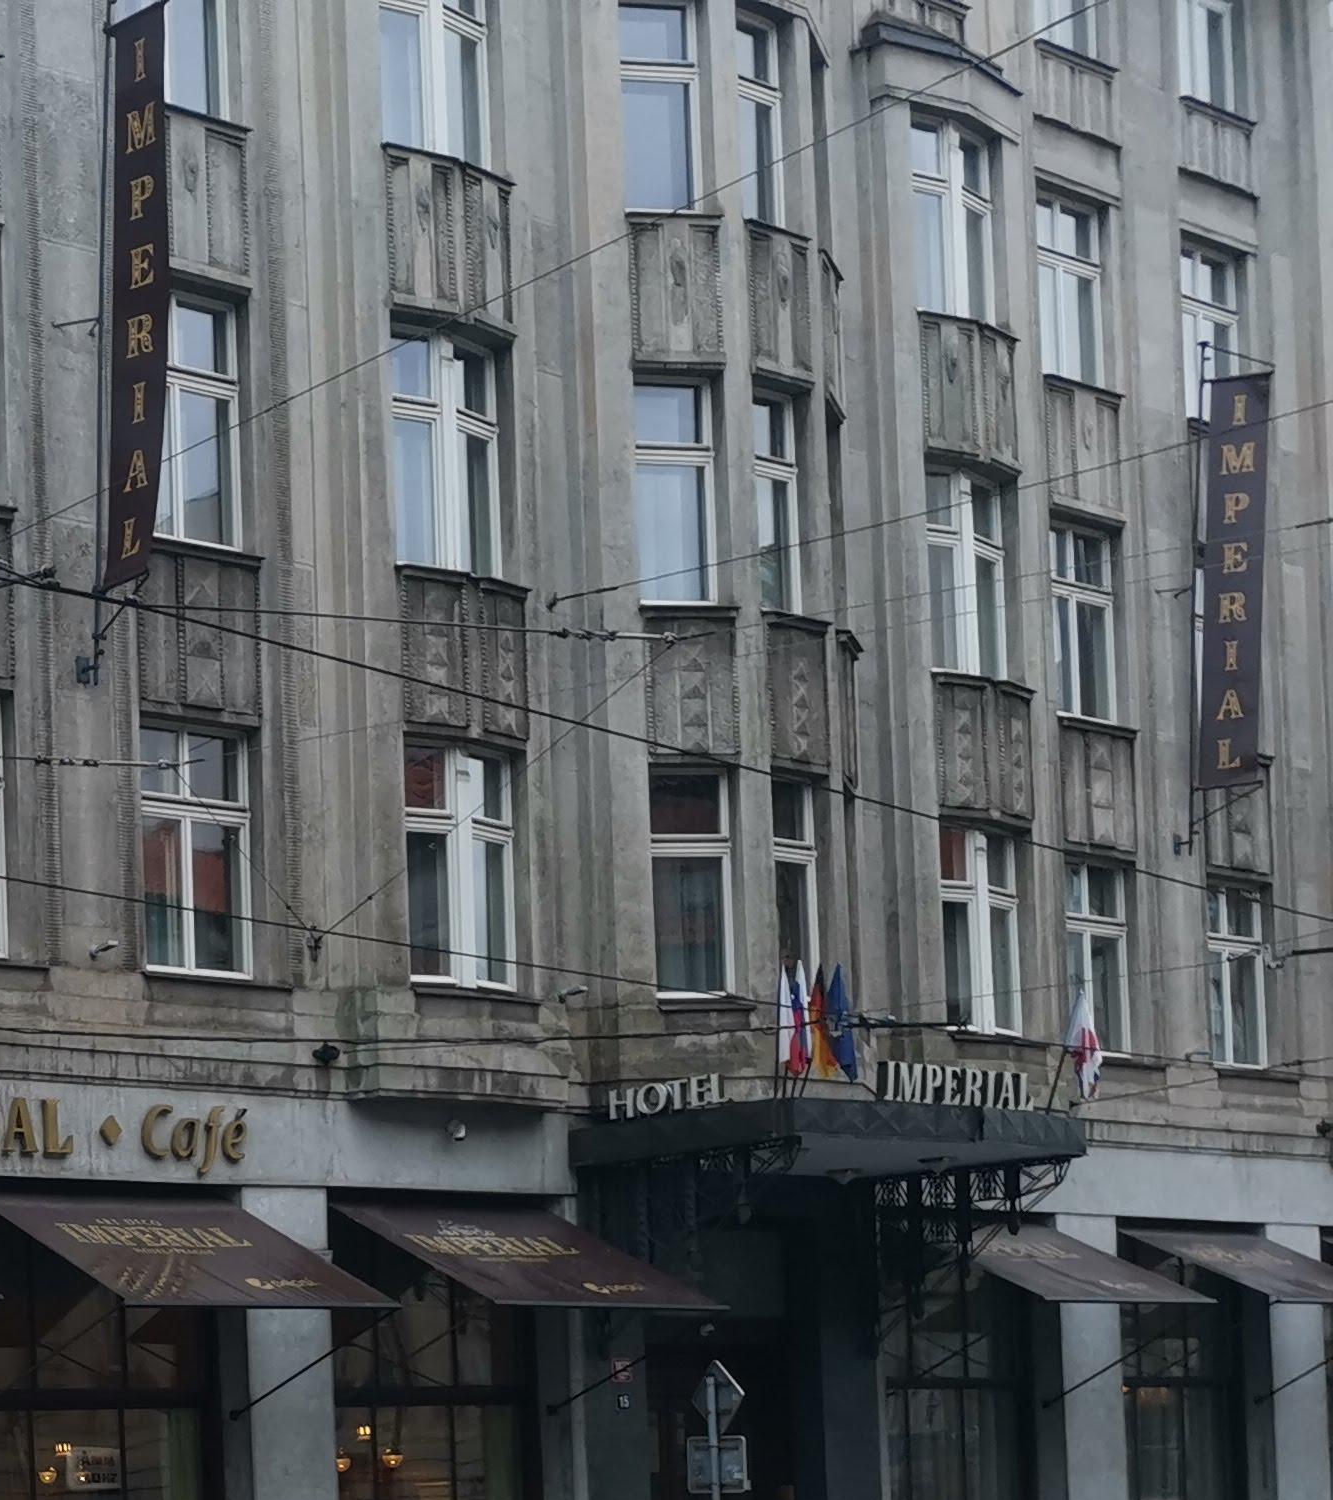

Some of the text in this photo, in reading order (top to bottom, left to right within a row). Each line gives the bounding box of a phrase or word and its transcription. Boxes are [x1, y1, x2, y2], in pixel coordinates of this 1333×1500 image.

[120, 37, 159, 560] IMPERIAL
[1216, 393, 1257, 771] IMPERIAL
[607, 1072, 732, 1121] HOTEL
[880, 1060, 1035, 1112] IMPERIAL
[140, 1104, 248, 1178] Café
[54, 1221, 254, 1248] IMPERIAL
